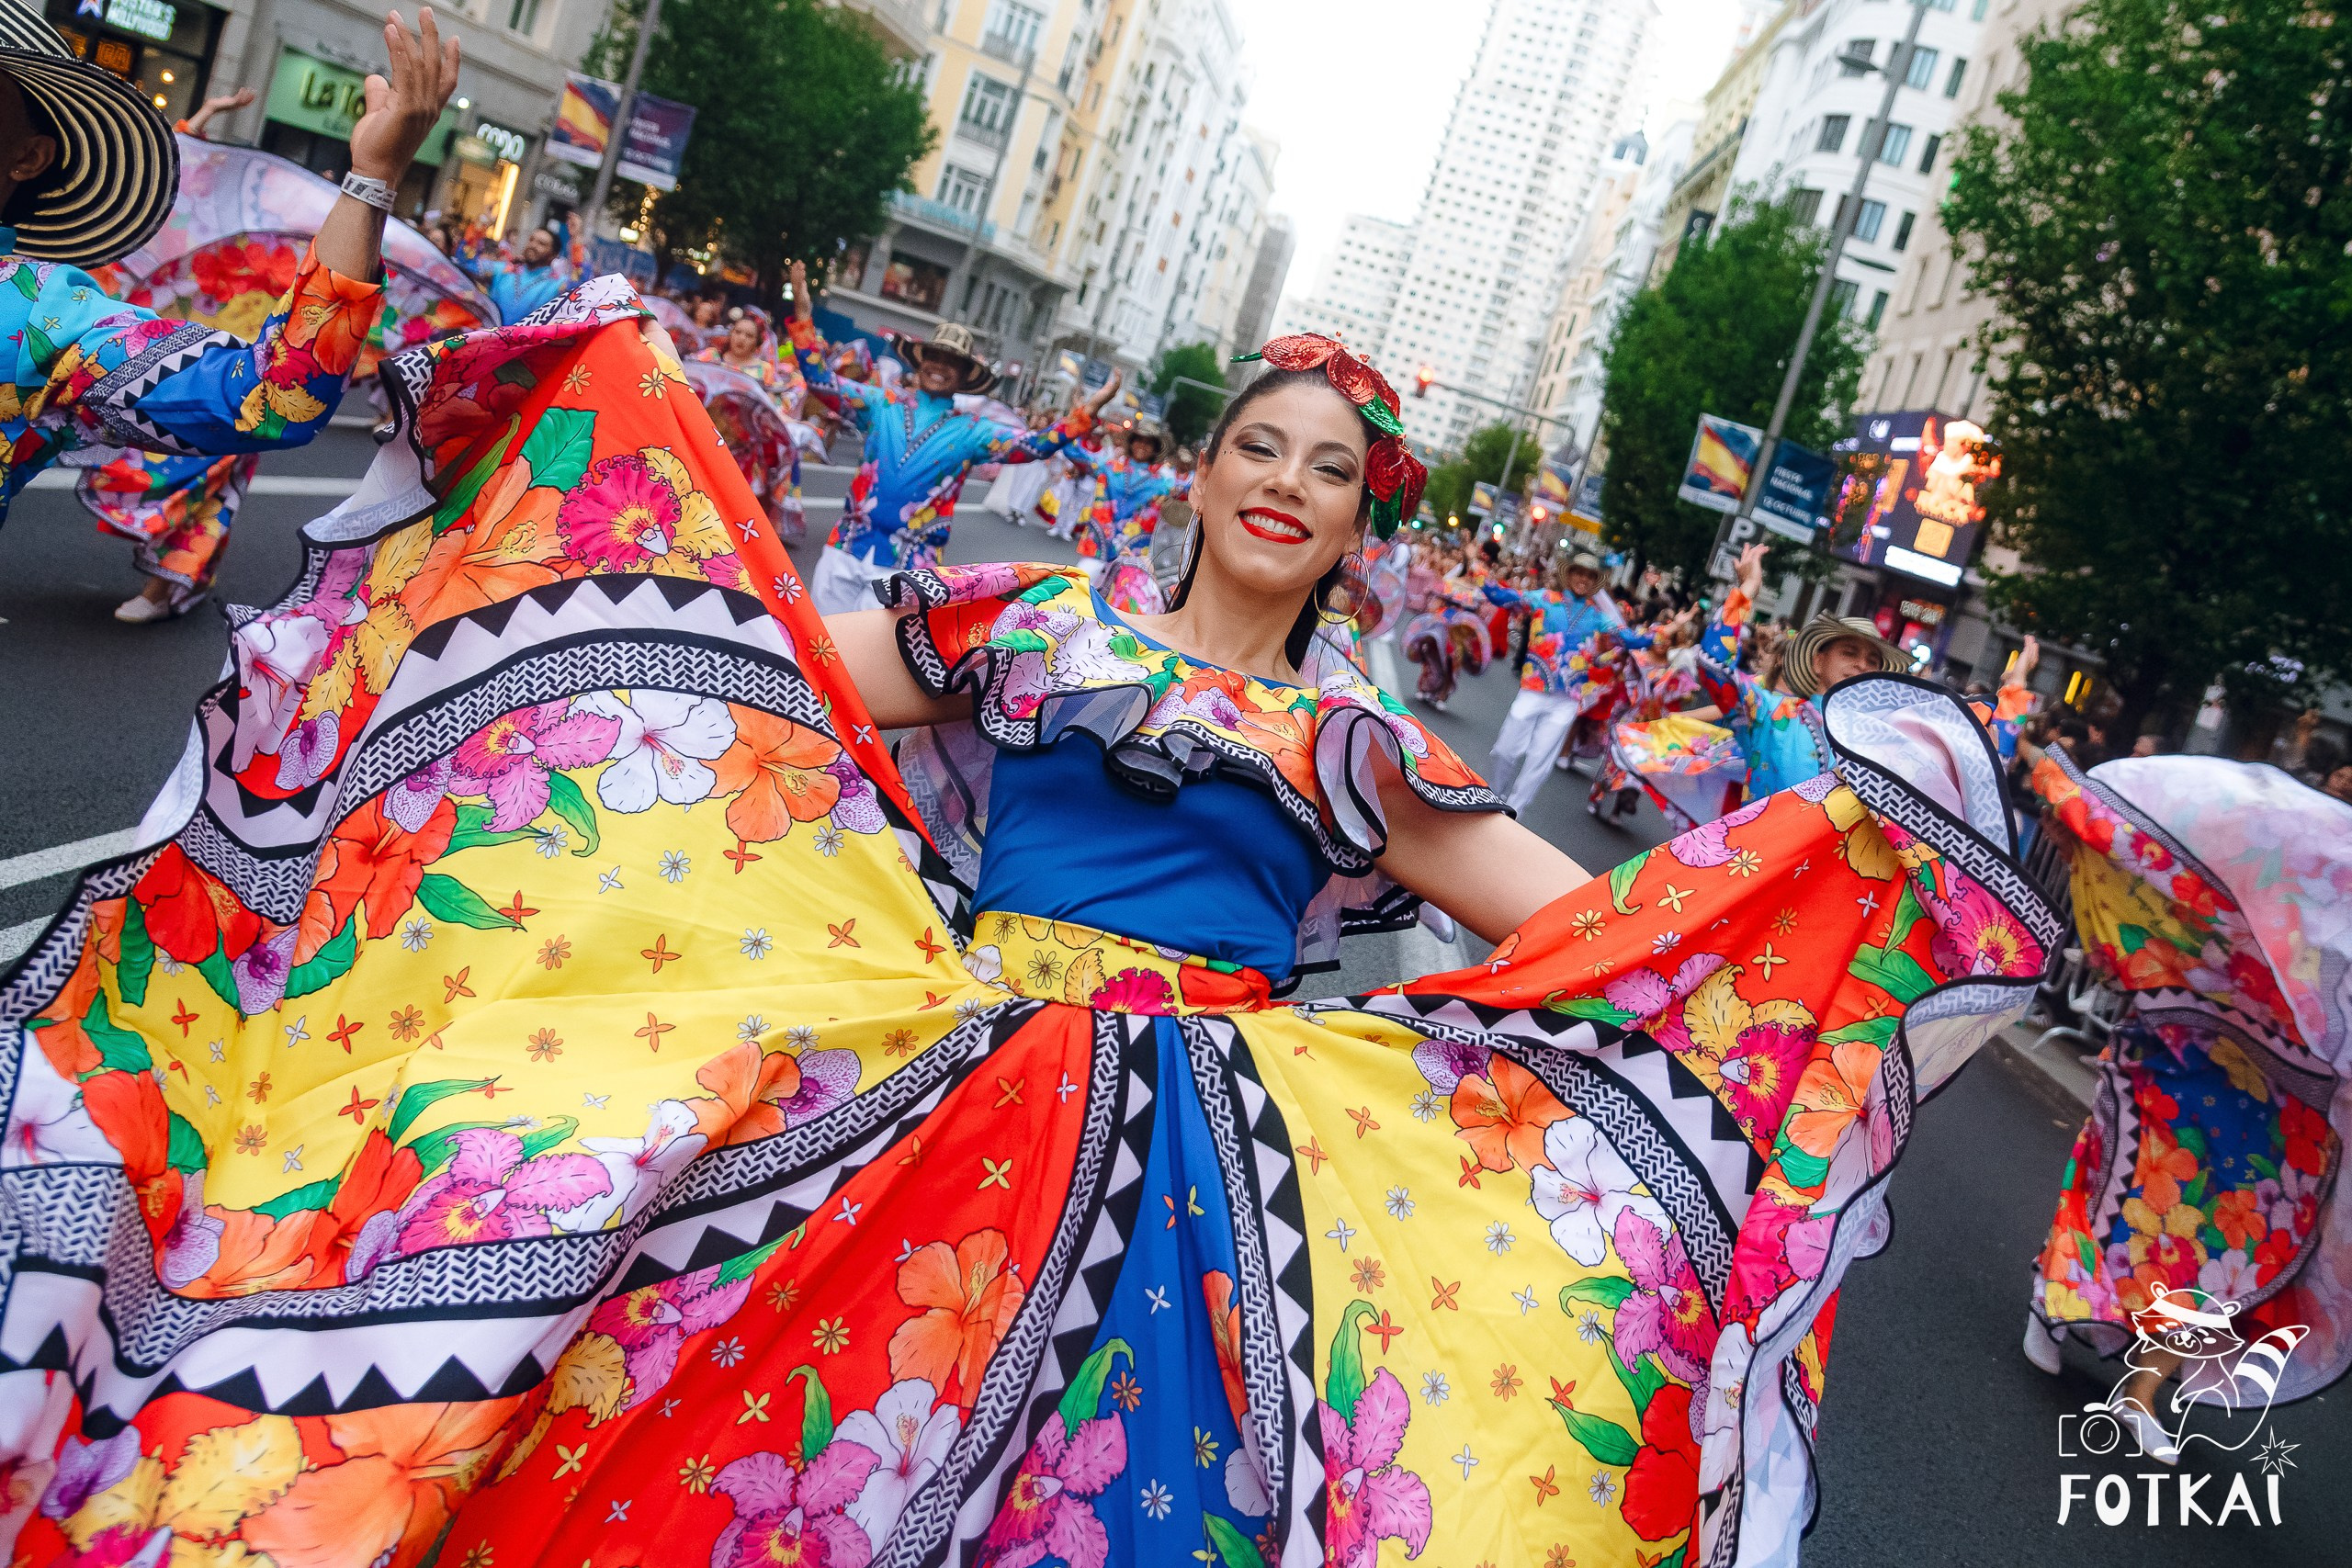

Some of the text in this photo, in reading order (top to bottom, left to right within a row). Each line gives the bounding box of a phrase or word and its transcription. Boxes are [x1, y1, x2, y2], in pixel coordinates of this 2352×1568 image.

[300, 67, 335, 109] La
[1770, 476, 1814, 502] NACIONAL
[1773, 501, 1812, 524] OCTUBRE
[1727, 516, 1756, 544] P
